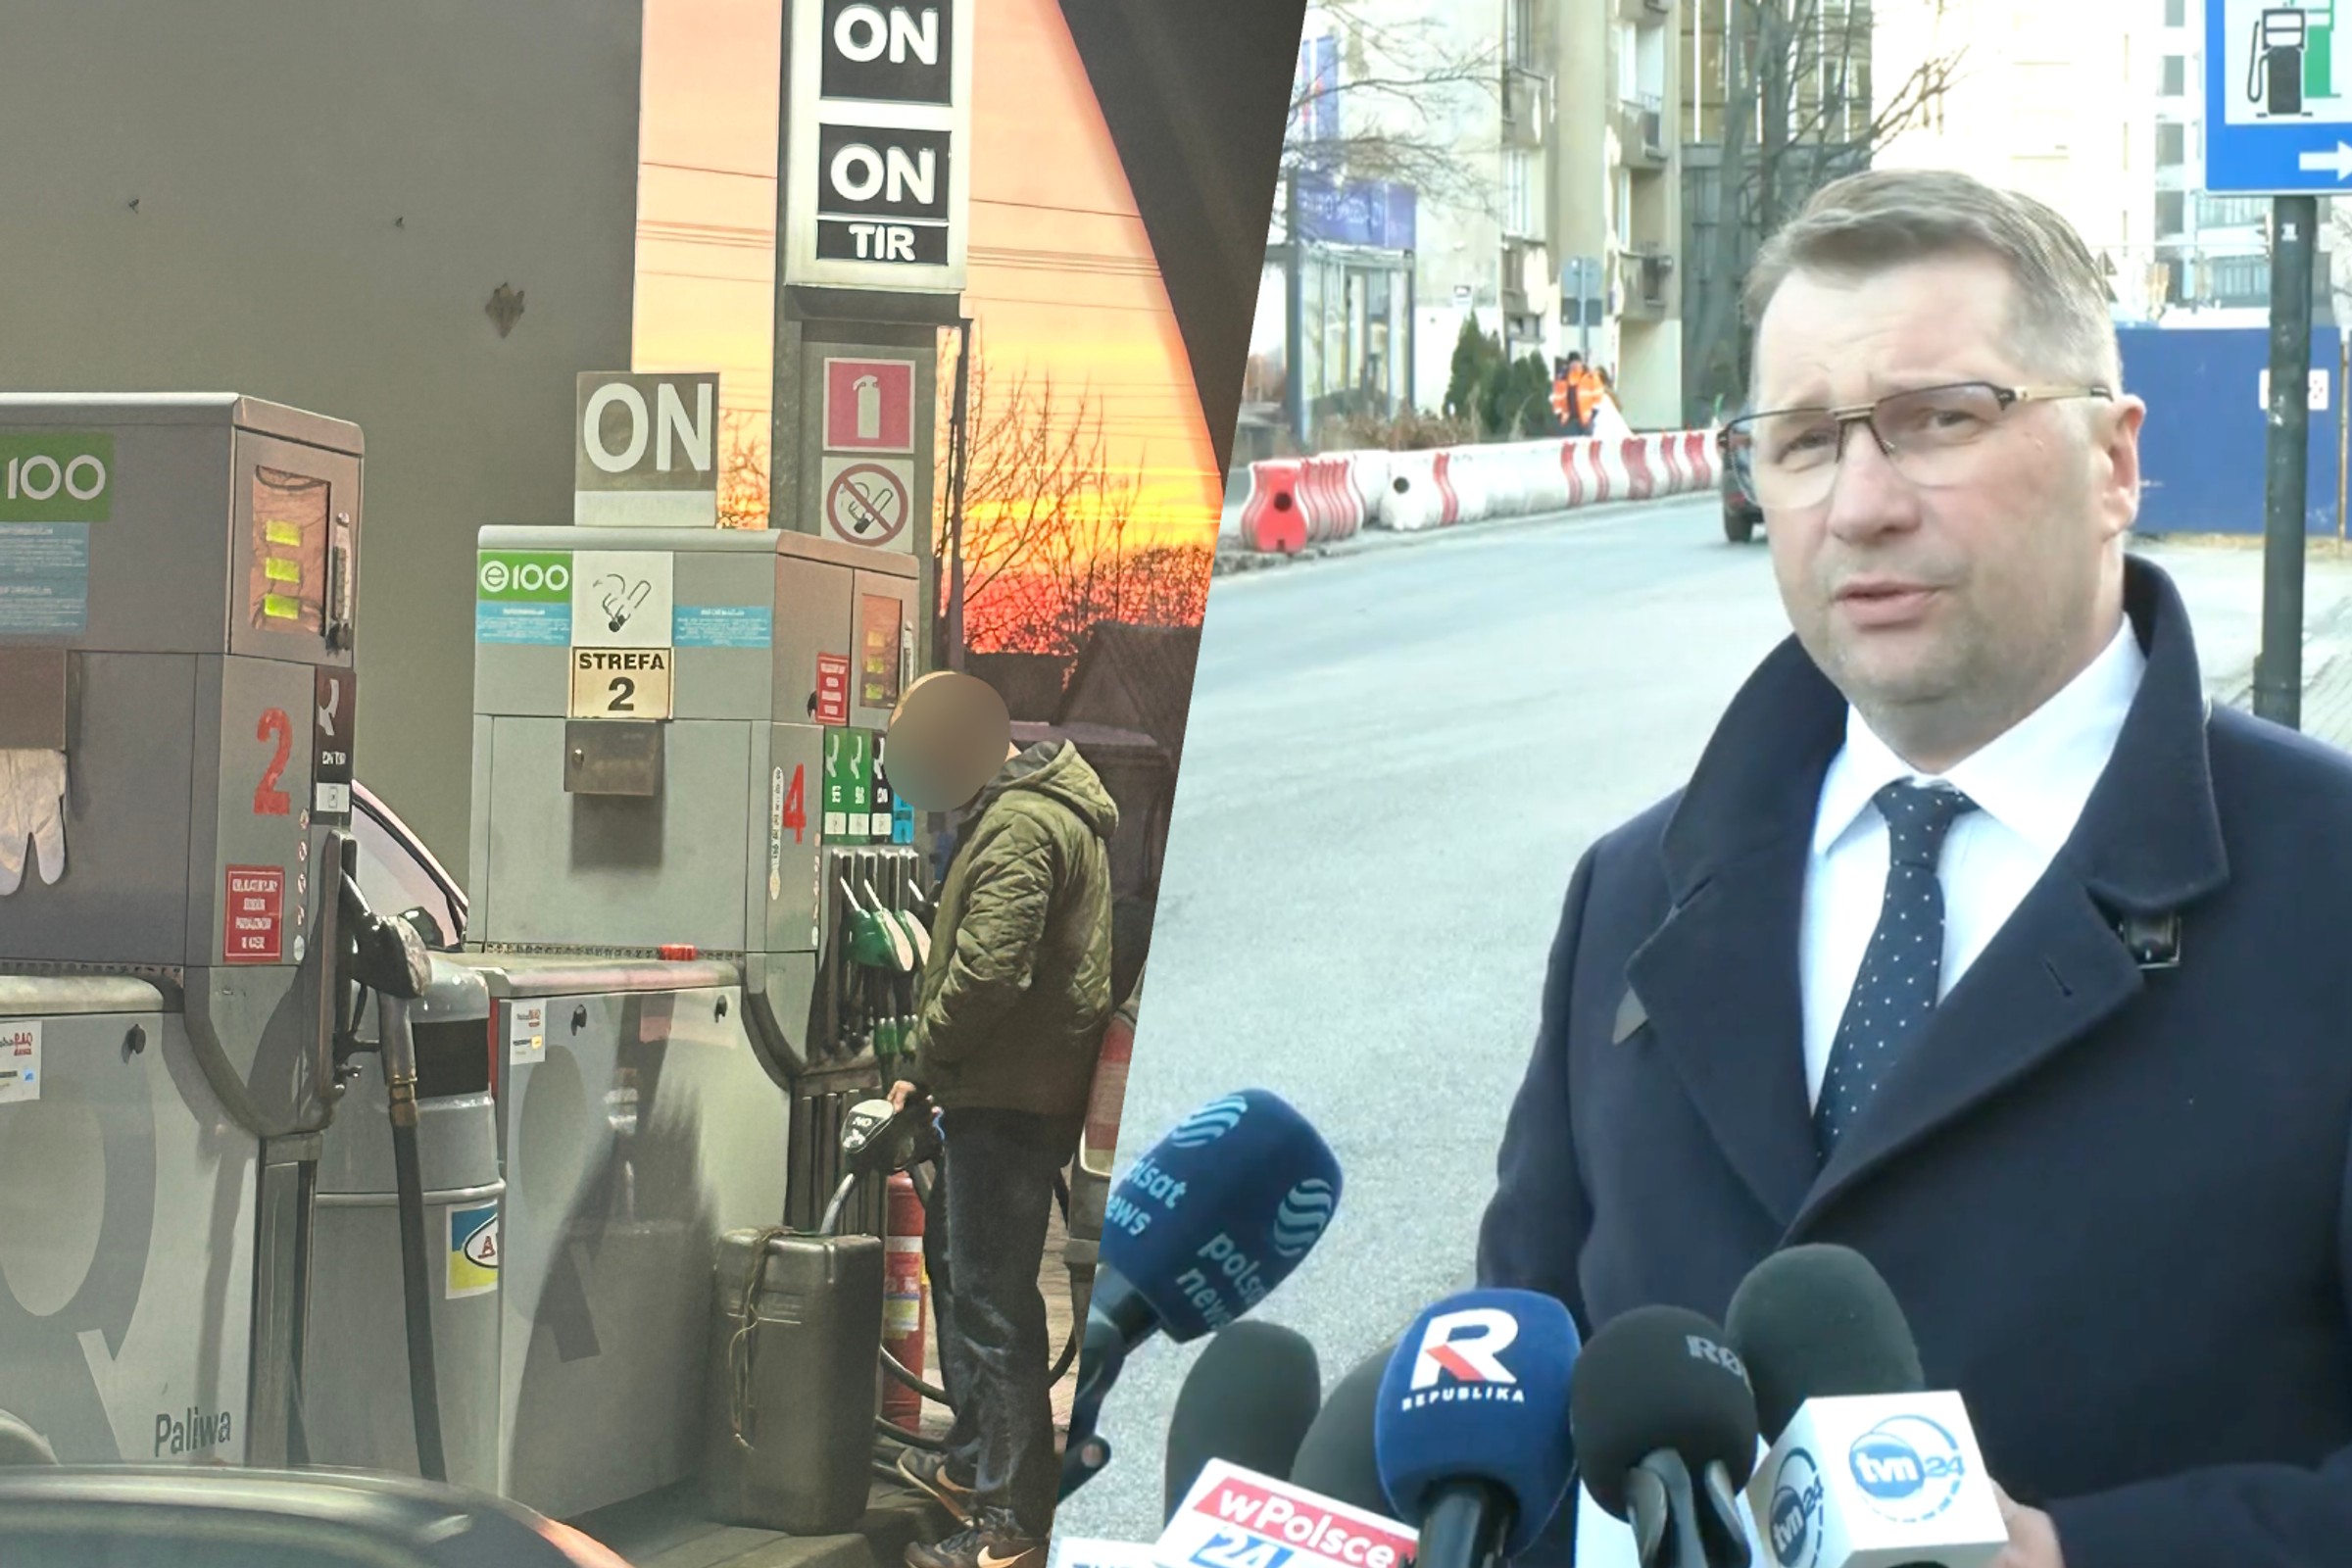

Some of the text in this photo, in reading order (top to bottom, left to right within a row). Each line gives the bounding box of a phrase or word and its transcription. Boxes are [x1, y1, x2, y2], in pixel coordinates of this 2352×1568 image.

[833, 3, 939, 66] ON
[830, 143, 937, 205] ON
[848, 223, 916, 262] TIR
[583, 382, 713, 473] ON
[578, 652, 665, 671] STREFA
[607, 675, 636, 711] 2
[253, 707, 293, 815] 2
[782, 761, 808, 846] 4
[1400, 1386, 1525, 1412] REPUBLIKA
[154, 1405, 231, 1458] Paliwa
[1854, 1451, 1966, 1483] tvn 24
[1218, 1488, 1396, 1568] wPolsce
[1772, 1473, 1824, 1553] tvn 24
